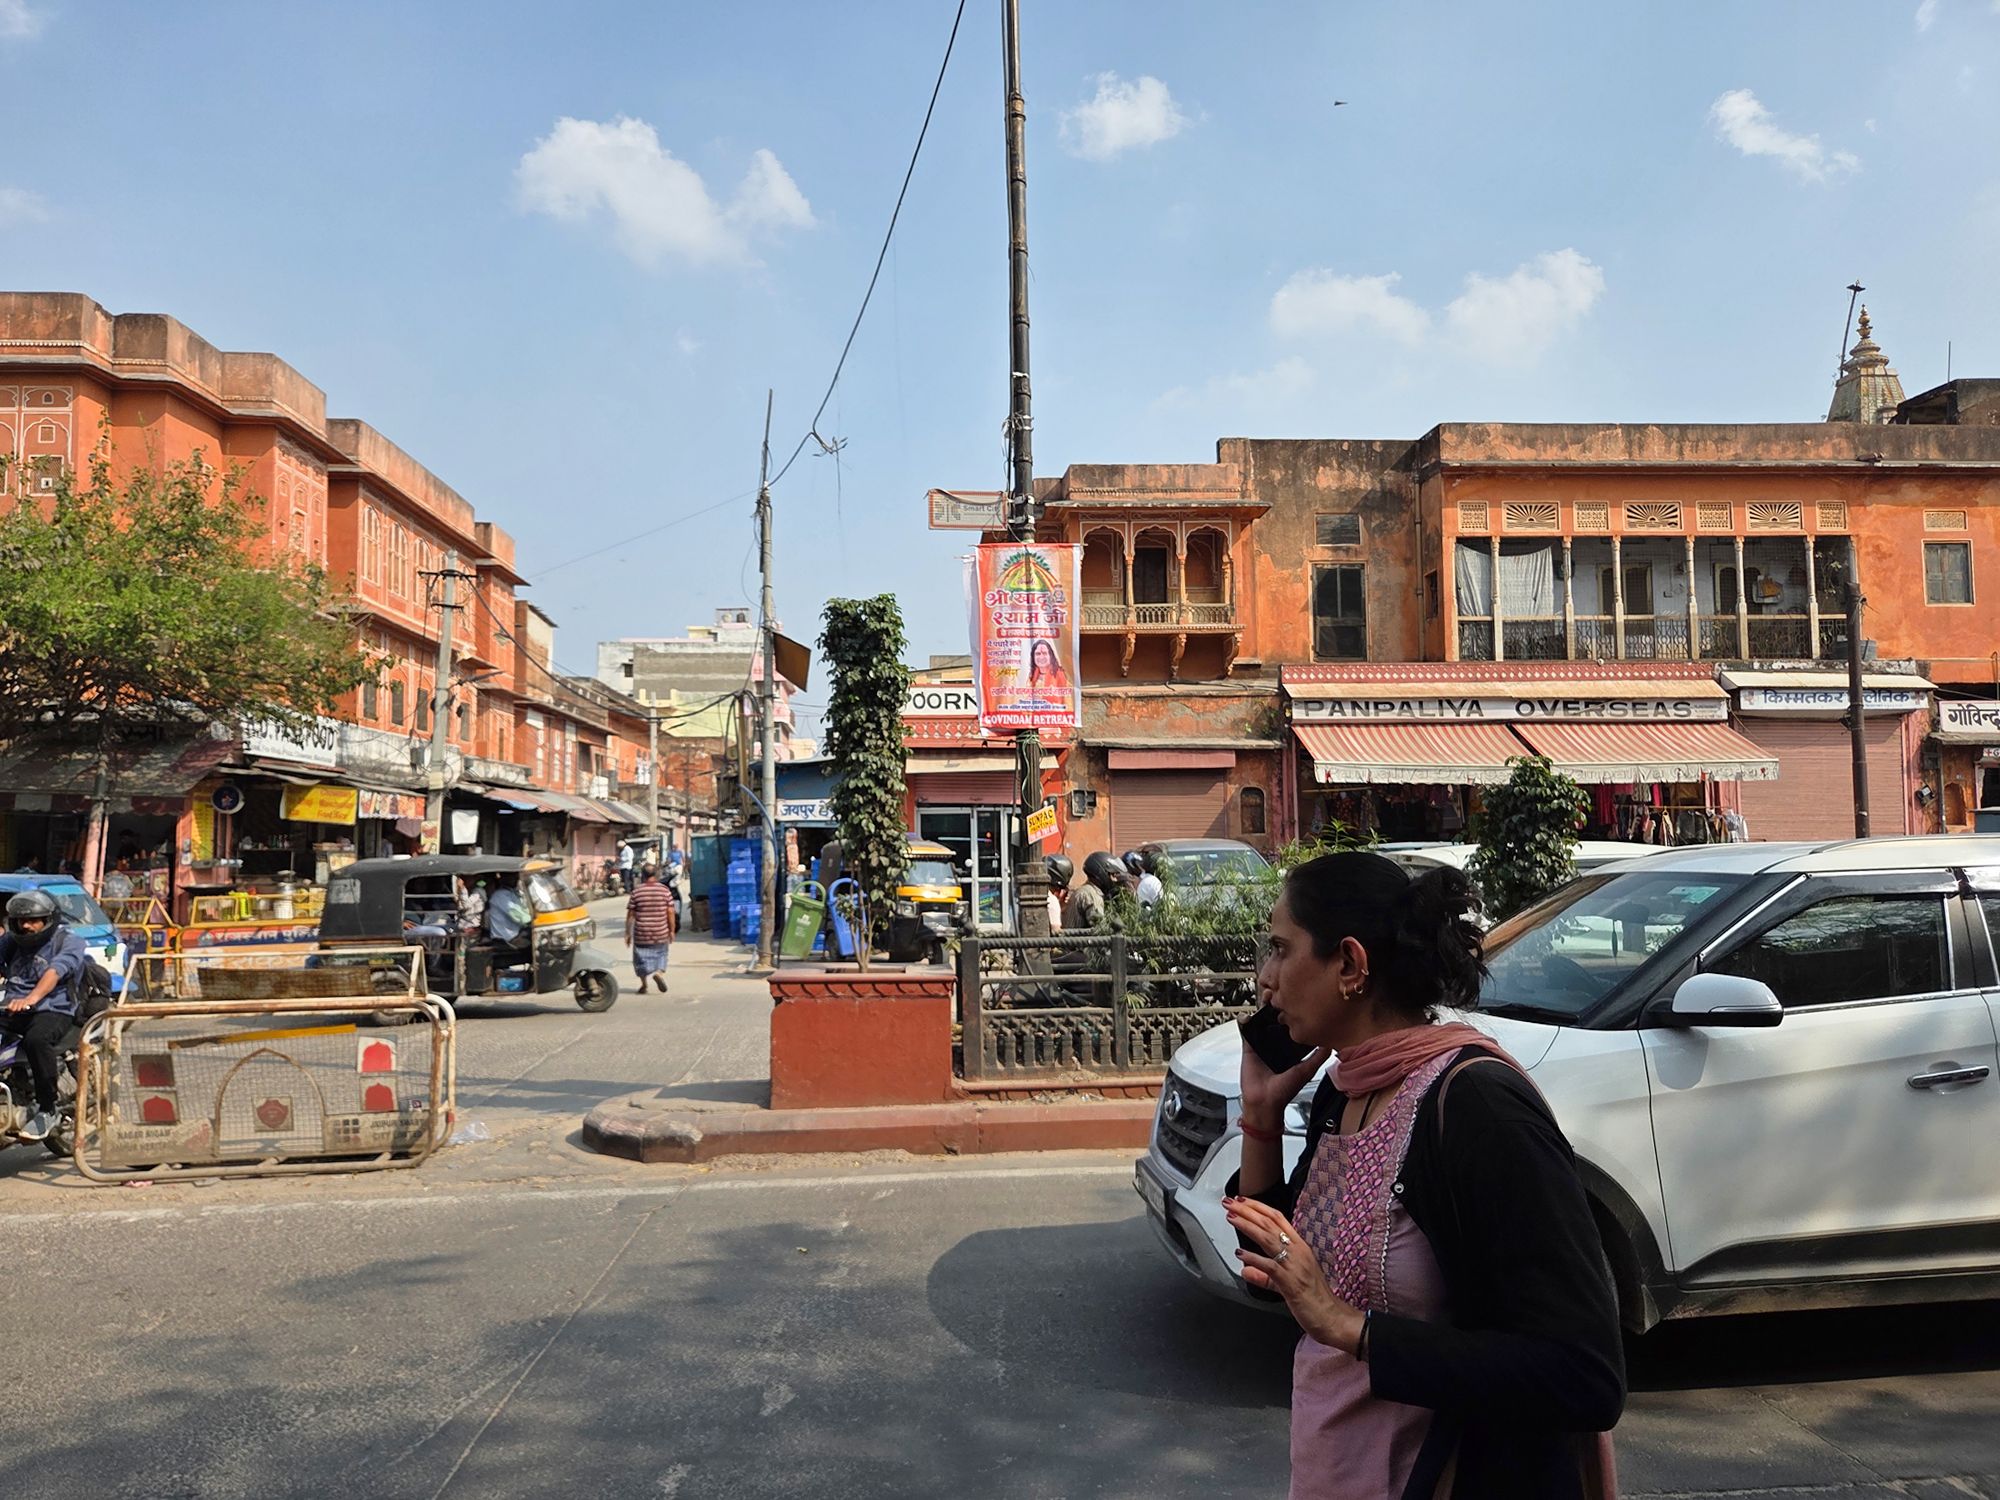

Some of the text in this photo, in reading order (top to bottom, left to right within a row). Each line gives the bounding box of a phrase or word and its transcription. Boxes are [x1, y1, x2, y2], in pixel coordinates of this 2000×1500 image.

[986, 590, 1010, 607] श्री
[1044, 608, 1066, 624] जी
[912, 692, 978, 710] OORN
[1303, 699, 1484, 718] PANPALIYA
[1515, 700, 1692, 718] OVERSEAS
[1034, 714, 1074, 725] RETREAT
[781, 803, 816, 819] जयपुर
